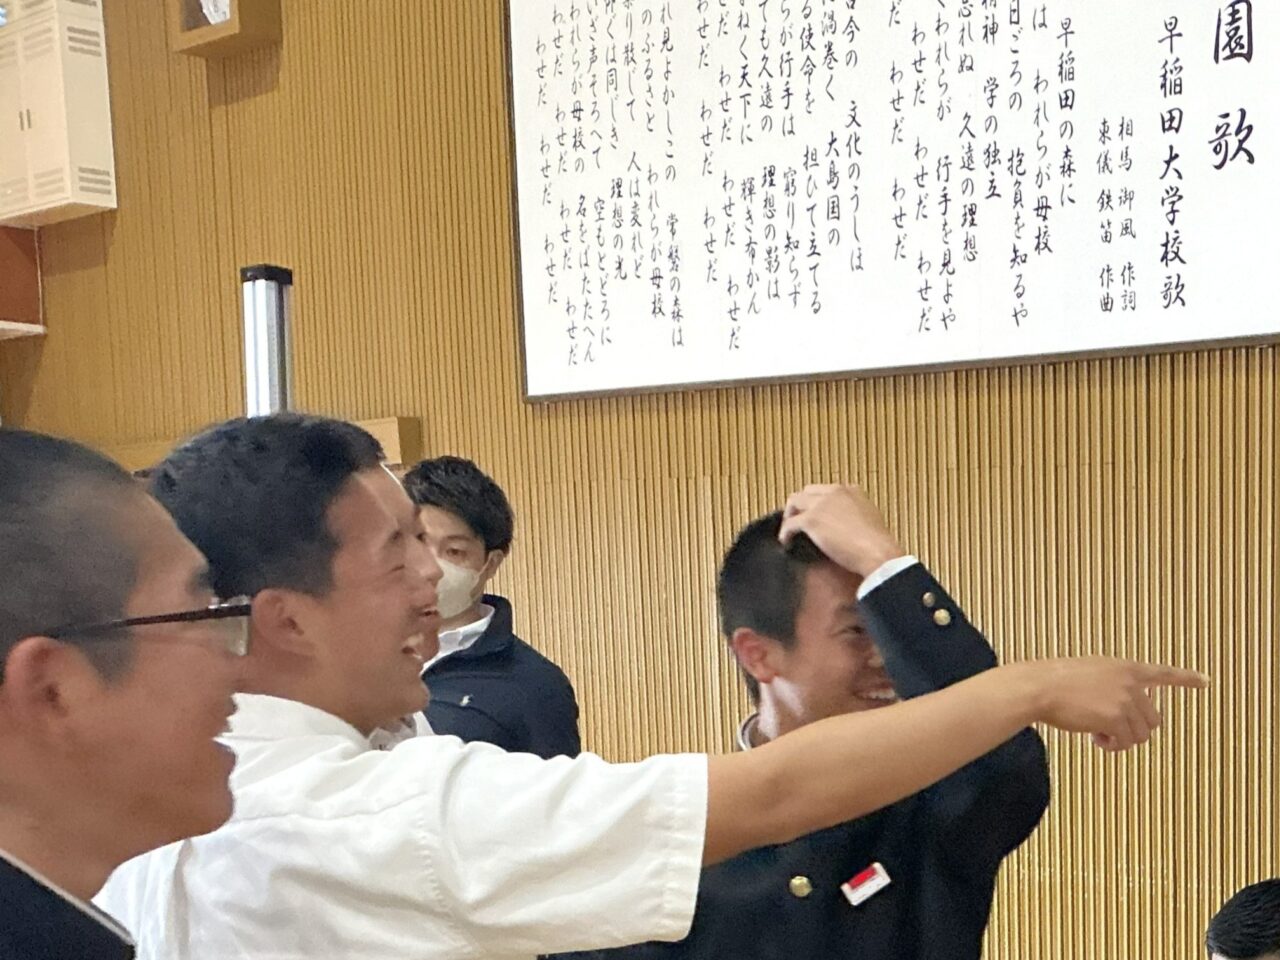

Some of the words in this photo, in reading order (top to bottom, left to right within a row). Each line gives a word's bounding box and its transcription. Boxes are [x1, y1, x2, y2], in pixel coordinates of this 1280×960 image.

[821, 0, 838, 101] 渦巻く
[1057, 17, 1076, 207] 早稲田の森に
[648, 165, 665, 318] われらが母校
[1033, 69, 1053, 255] われらが母校
[1158, 16, 1187, 309] 早稲田大学校歌
